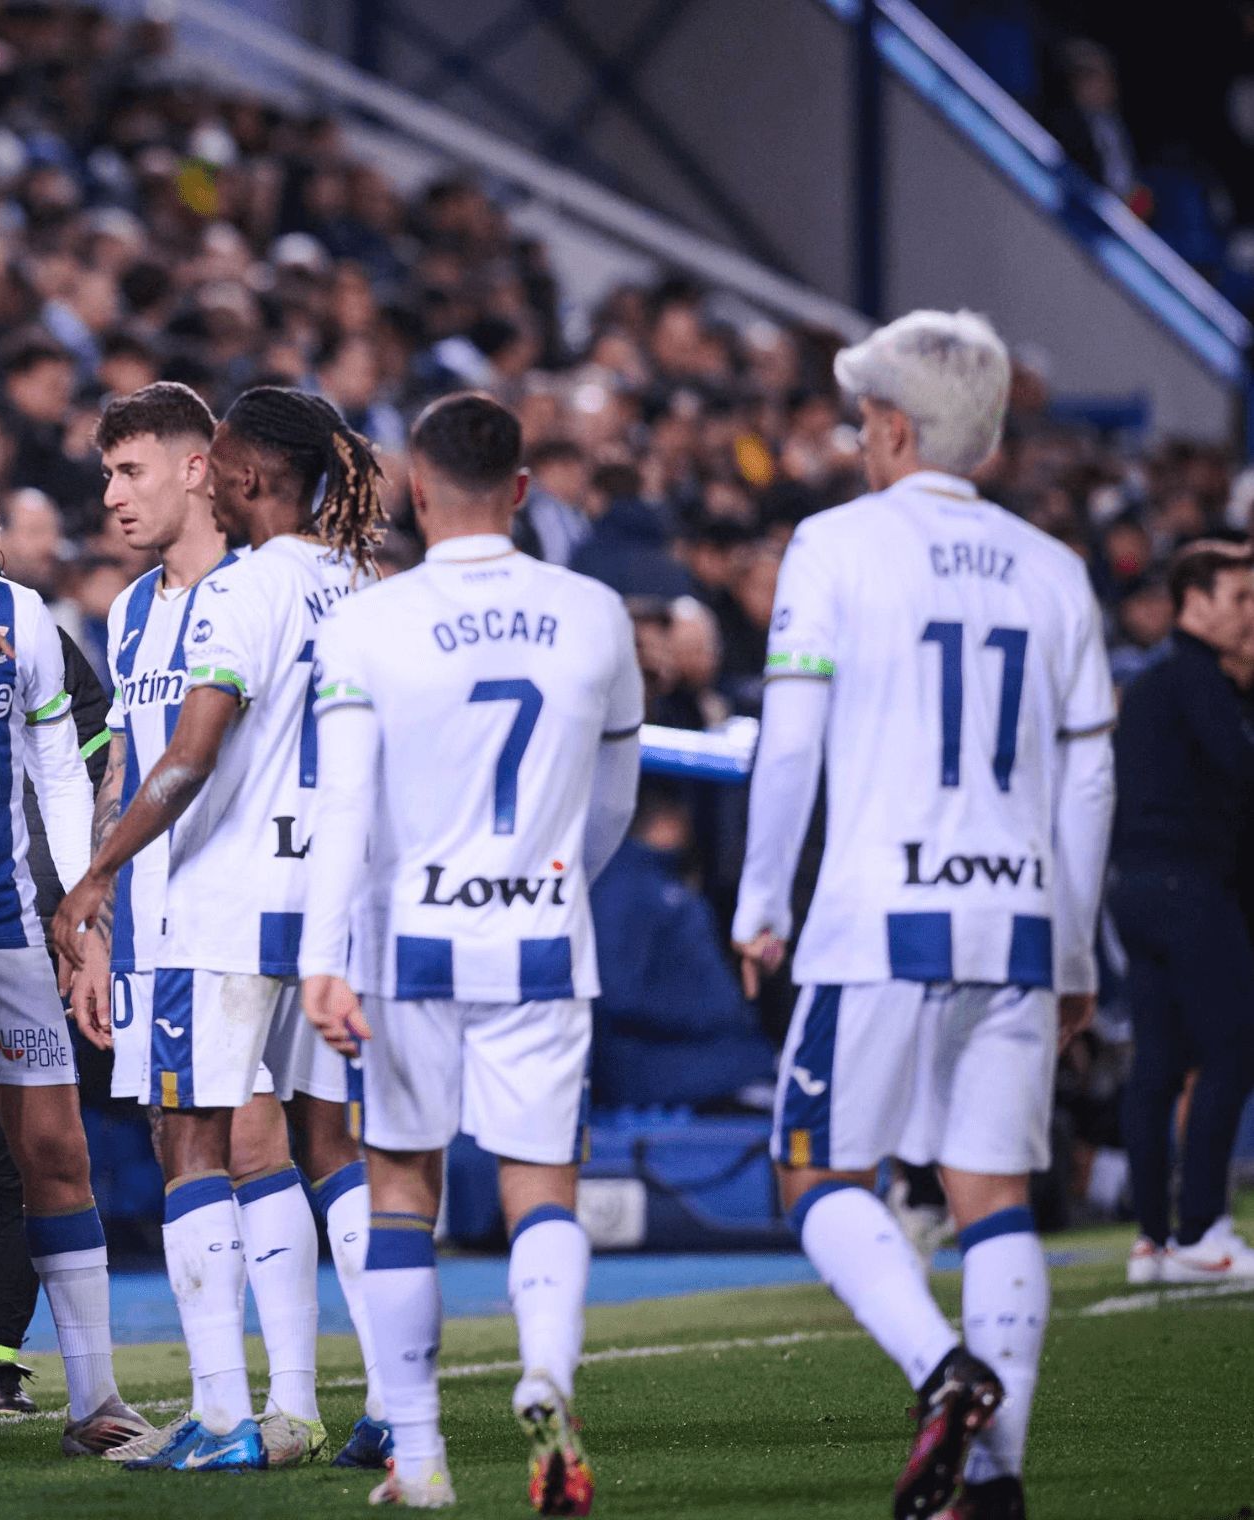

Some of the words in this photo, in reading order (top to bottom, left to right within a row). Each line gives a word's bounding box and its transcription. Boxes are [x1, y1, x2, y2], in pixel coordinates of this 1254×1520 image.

[929, 541, 1015, 584] CRUZ
[432, 608, 559, 652] OSCAR
[120, 668, 184, 707] ntim
[920, 620, 1029, 793] 11
[468, 678, 544, 835] 7
[419, 859, 566, 908] Lowi
[0, 1028, 59, 1049] URBAN
[27, 1047, 68, 1068] POKE
